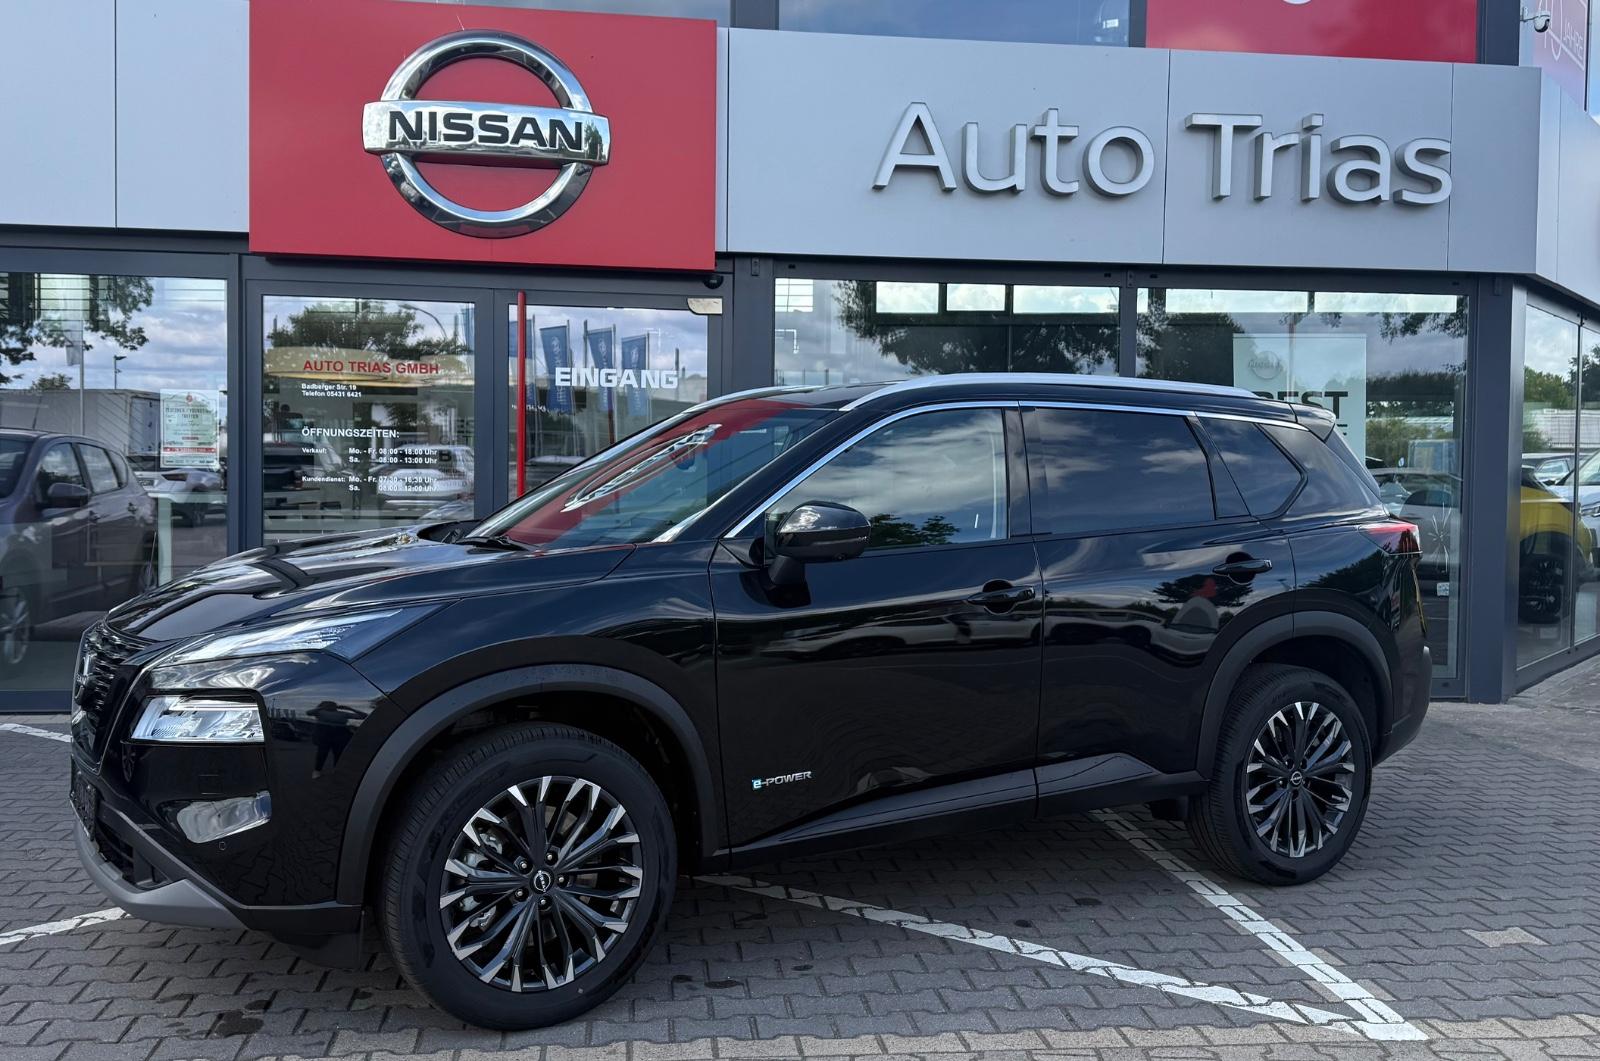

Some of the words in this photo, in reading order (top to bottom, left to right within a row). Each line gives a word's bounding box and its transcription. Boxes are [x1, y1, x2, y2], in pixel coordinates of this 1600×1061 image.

[388, 110, 583, 151] NISSAN
[872, 101, 1155, 198] Auto
[1184, 112, 1453, 206] Trias
[303, 360, 344, 372] AUTO
[348, 361, 391, 373] TRIAS
[395, 362, 439, 374] GMBH
[555, 367, 679, 389] EINGANG
[301, 426, 400, 438] ÖFFNUNGSZEITEN:
[752, 771, 812, 790] e-POWER
